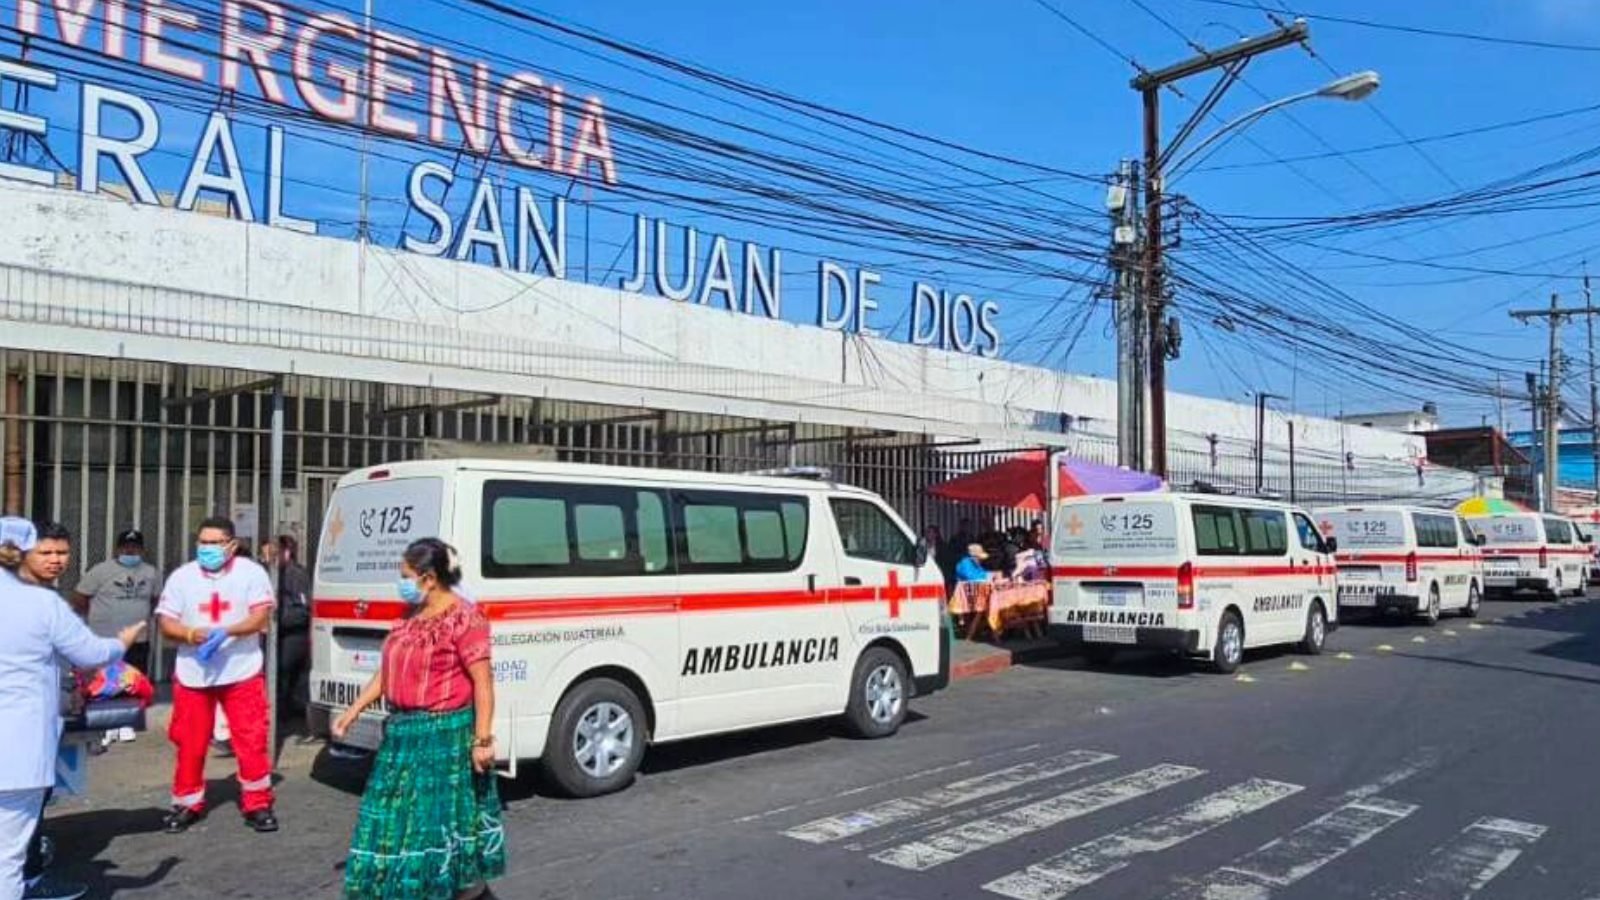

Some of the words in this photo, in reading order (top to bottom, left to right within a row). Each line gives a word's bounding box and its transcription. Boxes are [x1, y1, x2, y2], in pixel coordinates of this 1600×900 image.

[401, 161, 566, 280] SAN
[620, 213, 782, 319] JUAN
[817, 261, 882, 336] DE
[909, 281, 1000, 358] DIOS
[379, 505, 414, 534] 125
[1121, 514, 1154, 530] 125
[1067, 610, 1165, 626] AMBULANCIA
[681, 637, 839, 676] AMBULANCIA
